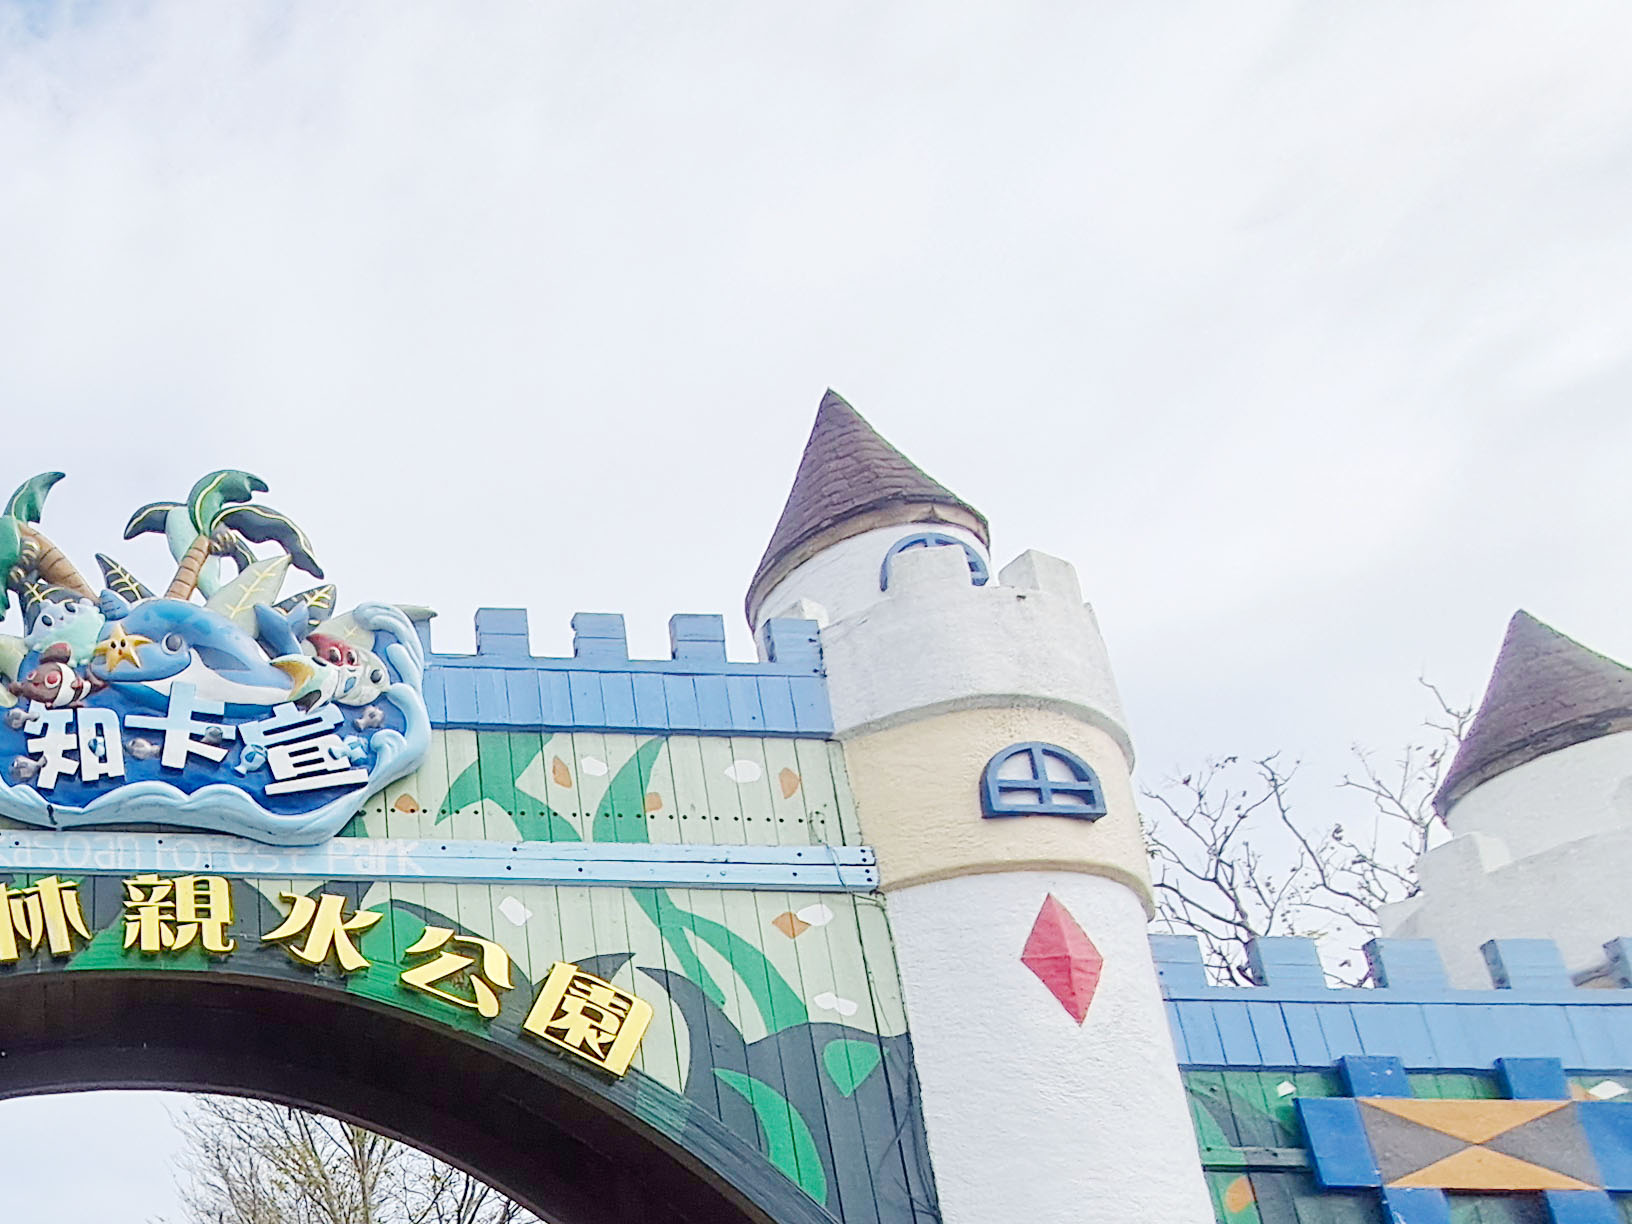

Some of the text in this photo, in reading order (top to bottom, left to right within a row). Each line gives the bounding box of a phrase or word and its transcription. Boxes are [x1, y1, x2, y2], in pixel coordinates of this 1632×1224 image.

[23, 681, 369, 796] 知卡宣
[328, 839, 423, 874] Park
